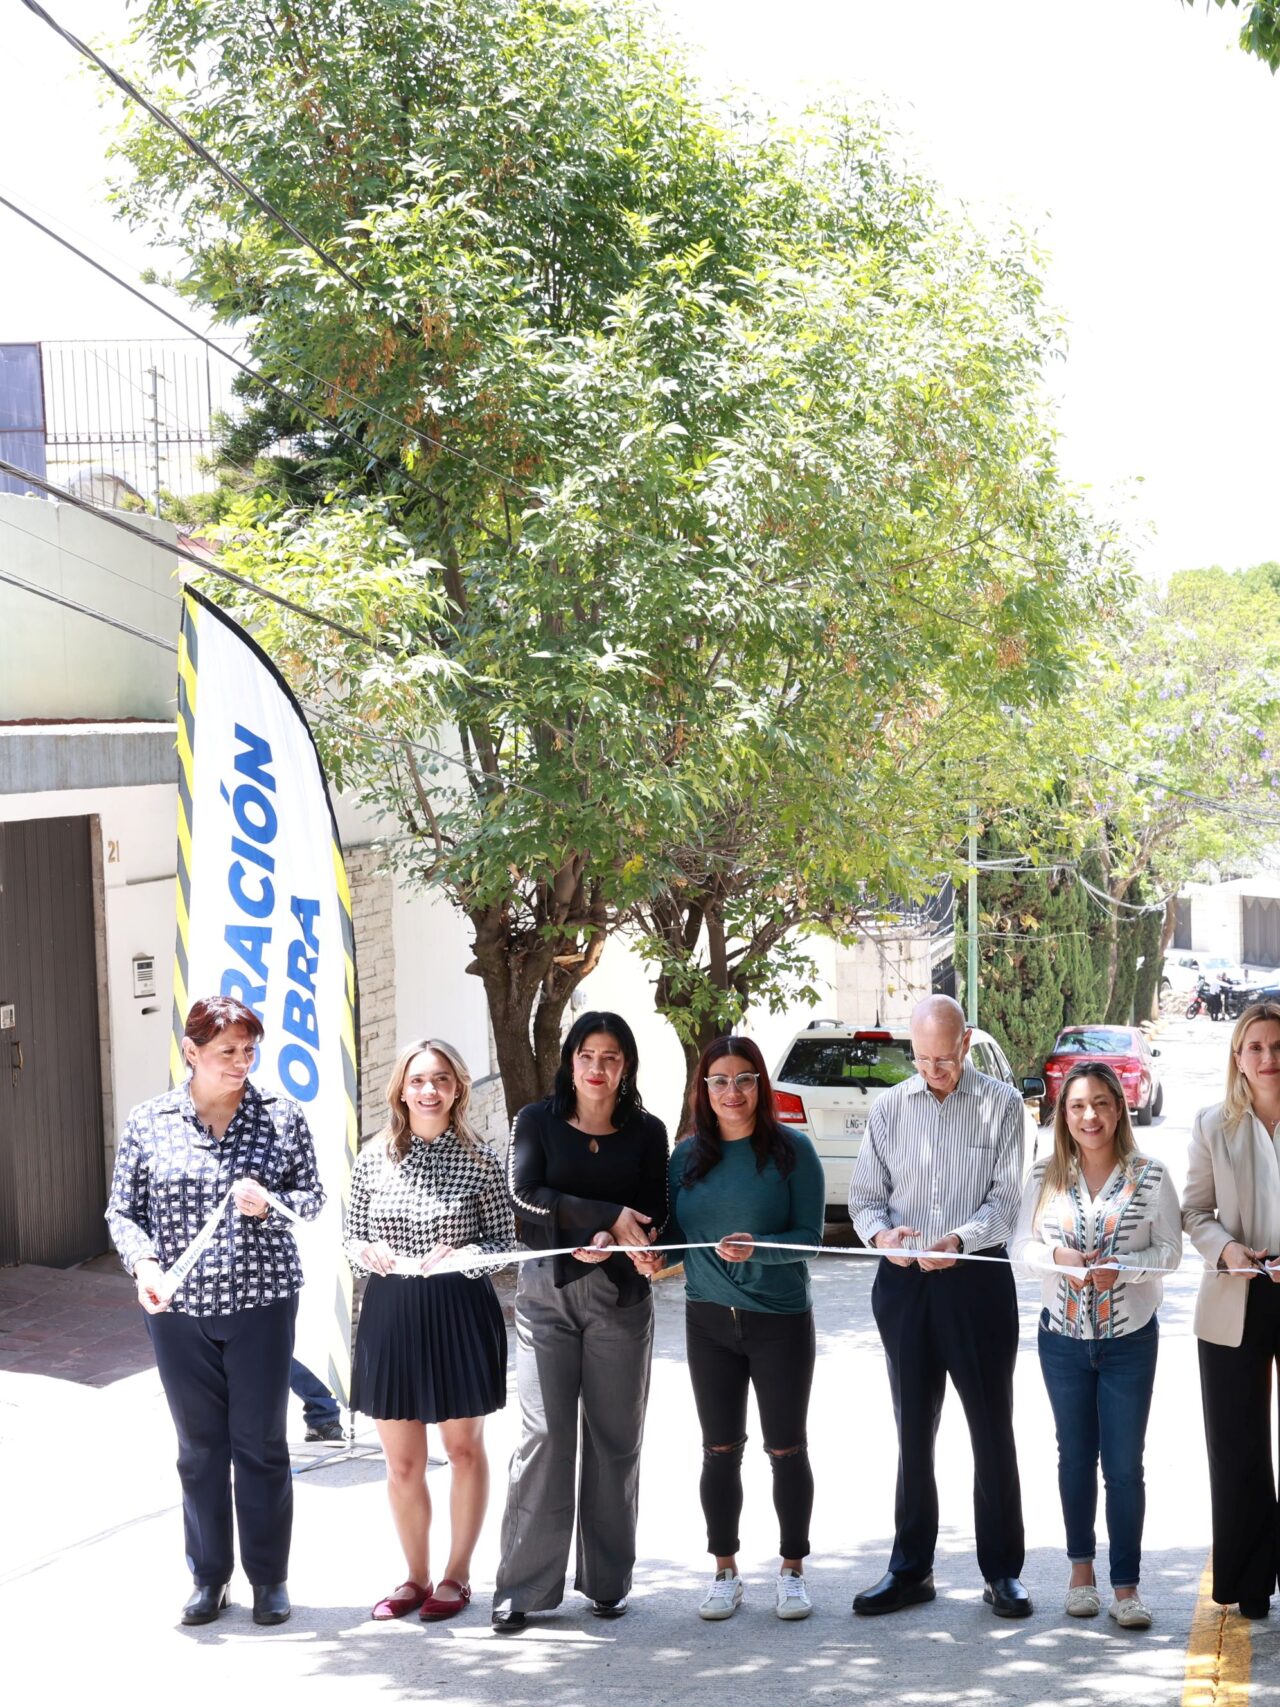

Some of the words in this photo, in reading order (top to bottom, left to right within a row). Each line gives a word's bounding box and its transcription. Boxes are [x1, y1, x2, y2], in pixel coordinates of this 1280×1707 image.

[107, 840, 120, 863] 21
[219, 722, 278, 1074] RACIÓN
[278, 895, 320, 1103] OBRA
[845, 1119, 867, 1129] LNG-1
